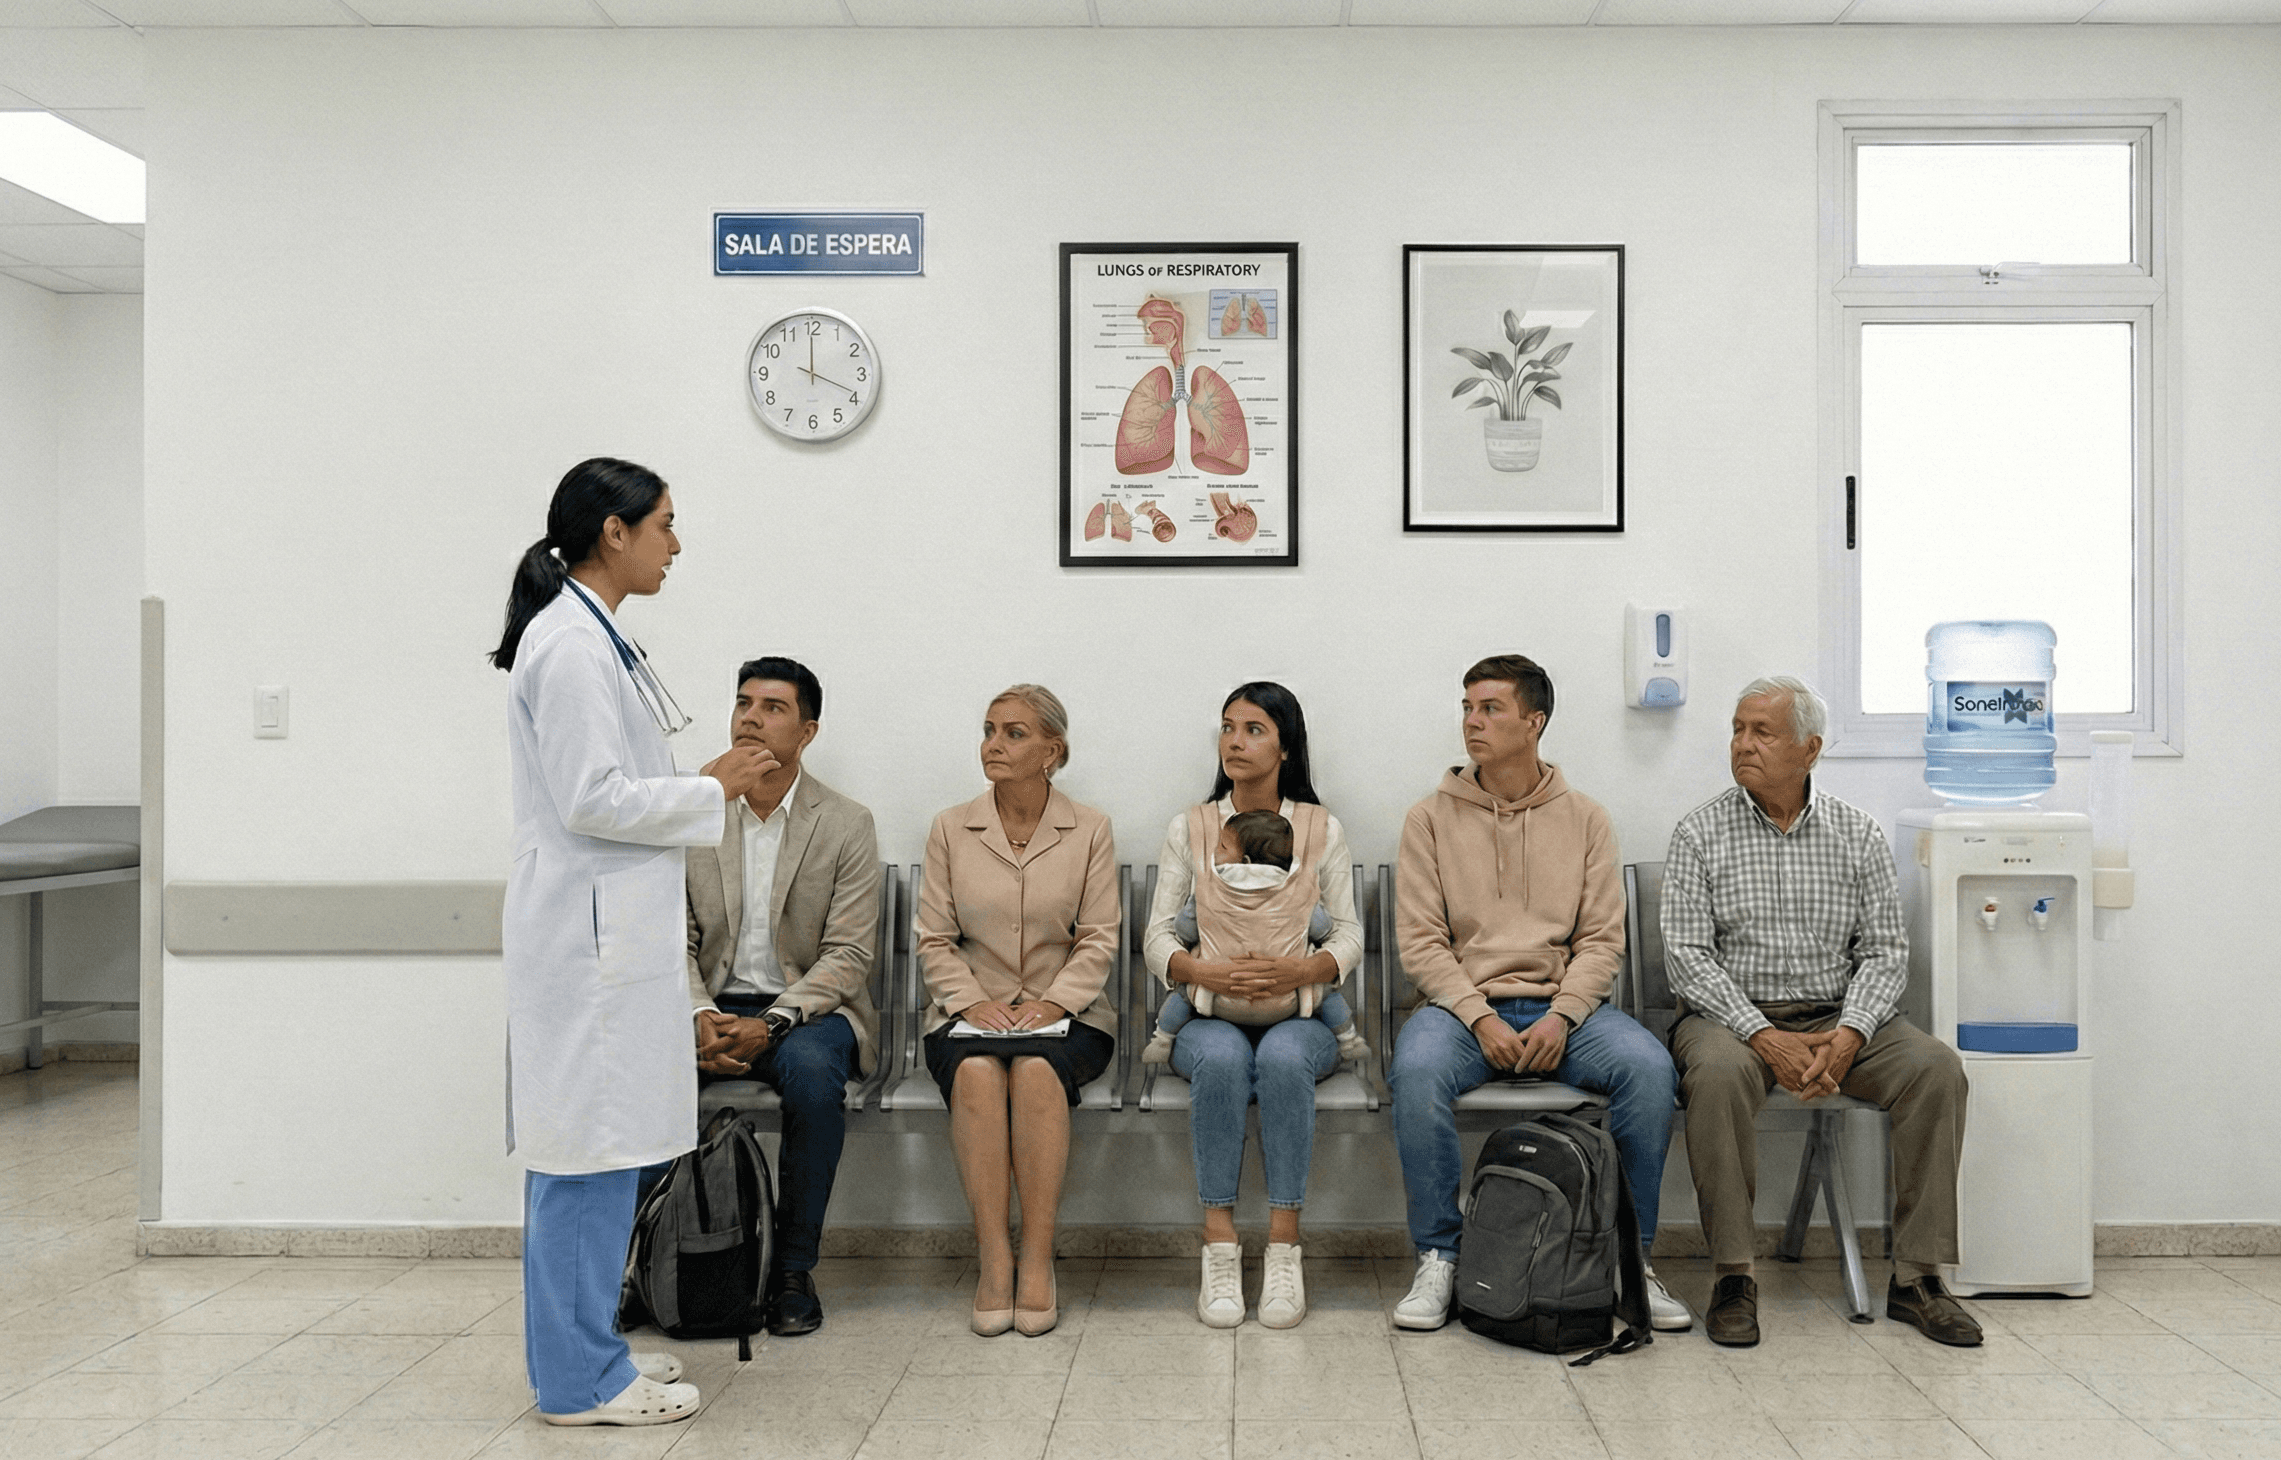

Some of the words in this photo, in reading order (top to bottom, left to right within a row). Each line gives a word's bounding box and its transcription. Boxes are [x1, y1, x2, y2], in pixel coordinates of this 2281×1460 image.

[725, 233, 784, 255] SALA
[790, 233, 819, 255] DE
[826, 233, 912, 255] ESPERA
[1097, 264, 1145, 277] LUNGS
[1147, 266, 1163, 277] OF
[1167, 264, 1261, 277] RESPIRATORY
[780, 326, 796, 342] 11
[804, 320, 821, 336] 12
[833, 324, 841, 342] 1
[762, 343, 781, 359] 10
[849, 342, 860, 358] 2
[758, 365, 769, 382] 9
[856, 366, 867, 382] 3
[765, 390, 776, 405] 8
[849, 391, 860, 406] 4
[783, 408, 794, 422] 7
[808, 414, 818, 430] 6
[832, 407, 843, 423] 5
